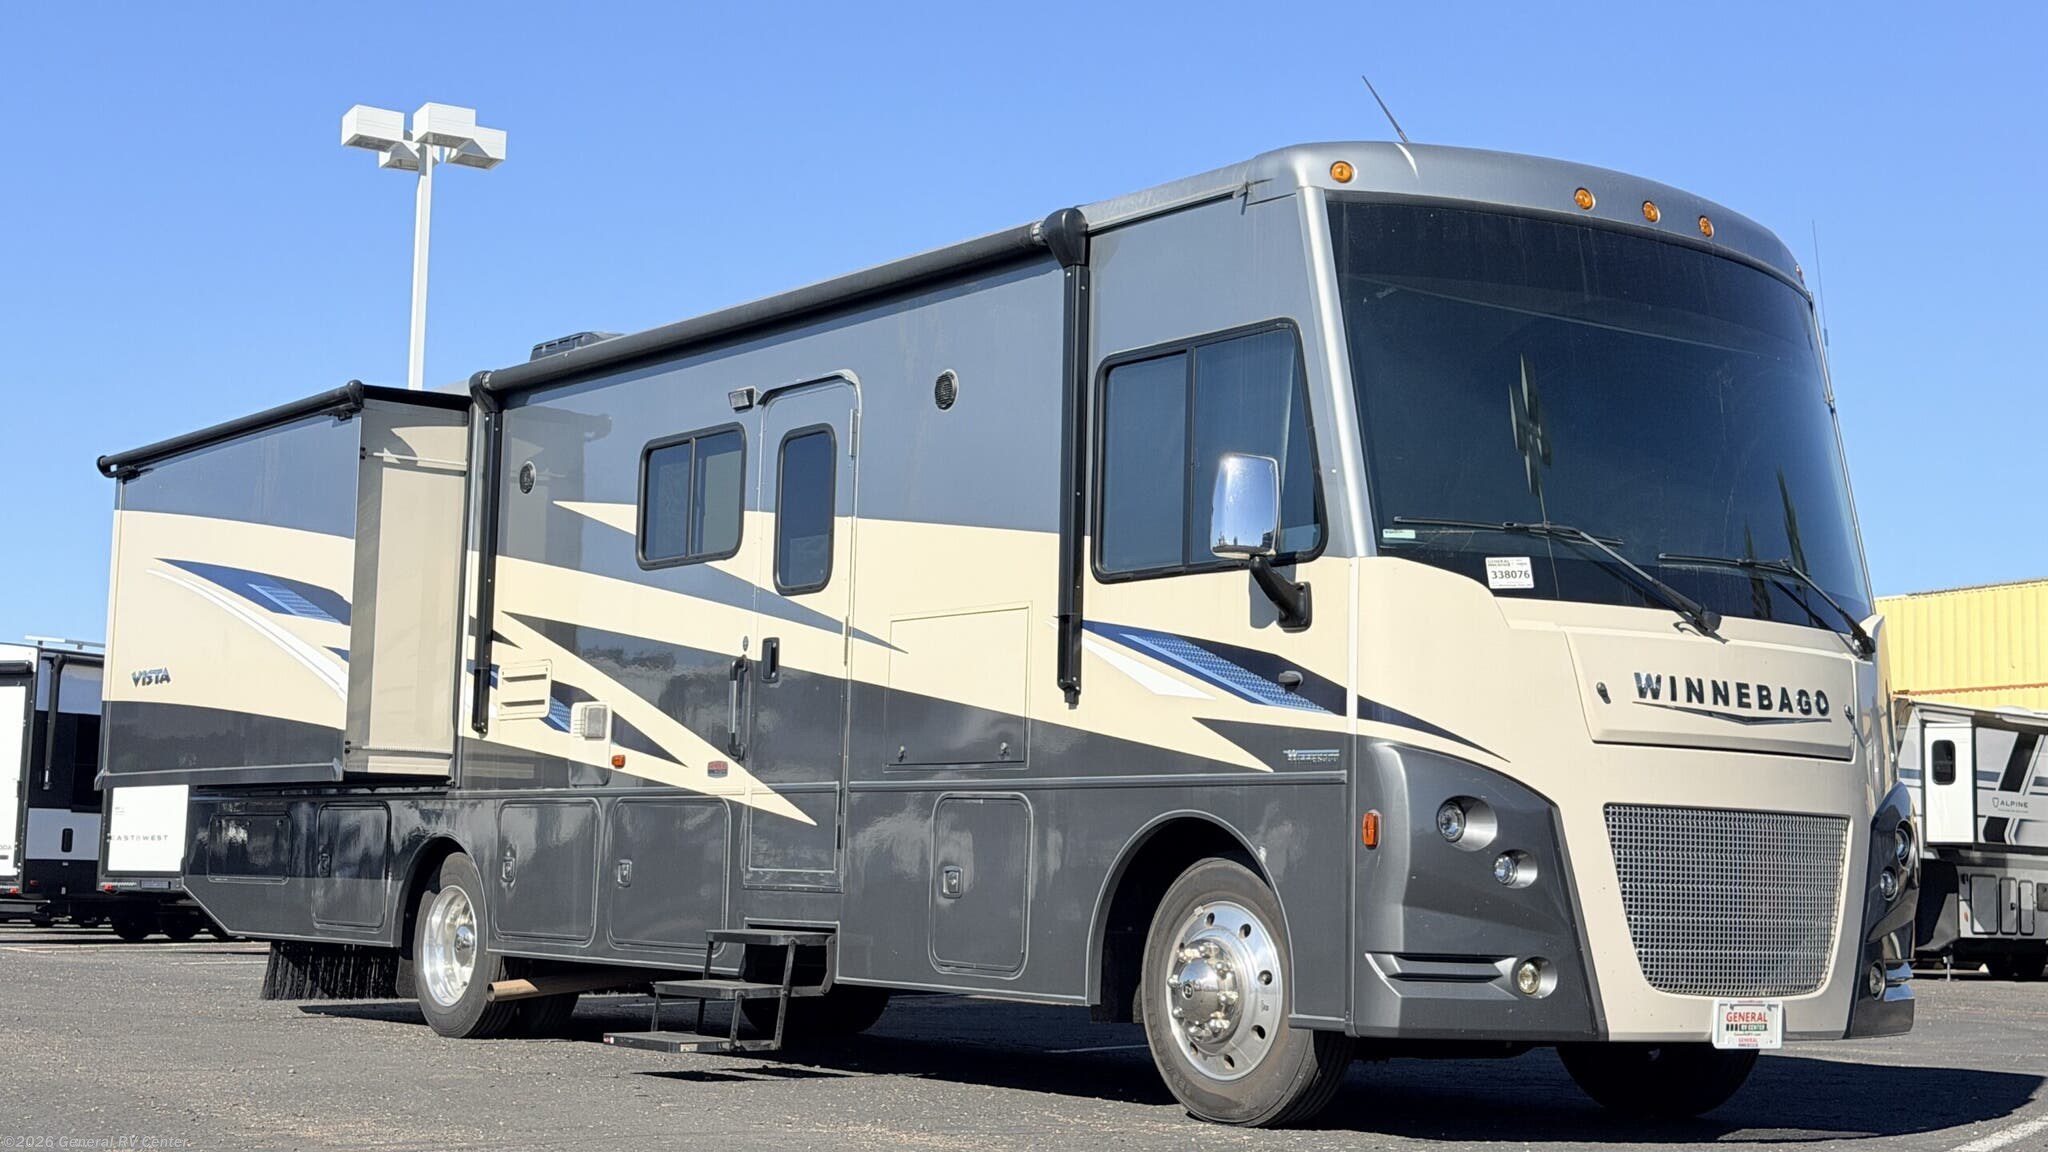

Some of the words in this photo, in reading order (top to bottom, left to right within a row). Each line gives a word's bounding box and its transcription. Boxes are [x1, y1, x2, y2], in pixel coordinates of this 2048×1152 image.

[1491, 570, 1530, 579] 338076
[131, 667, 171, 687] VISTA
[1634, 672, 1830, 716] WINNEBAGO
[2000, 799, 2028, 808] ALPINE
[1726, 1011, 1768, 1022] GENERAL
